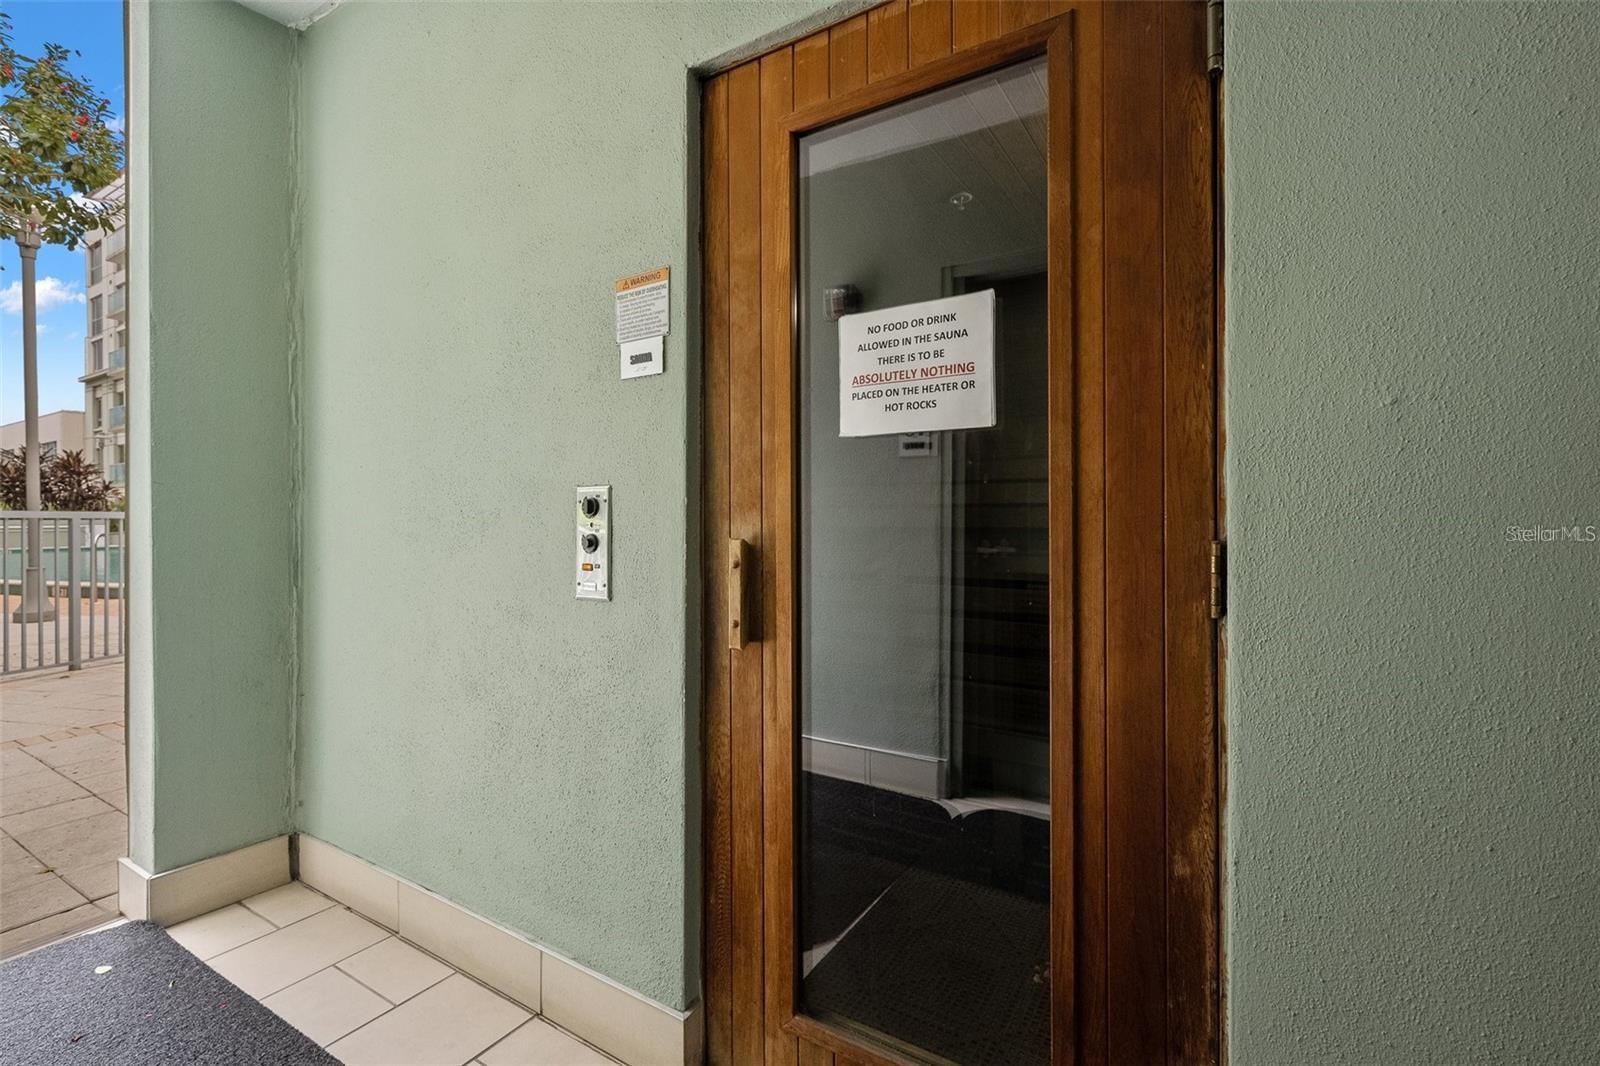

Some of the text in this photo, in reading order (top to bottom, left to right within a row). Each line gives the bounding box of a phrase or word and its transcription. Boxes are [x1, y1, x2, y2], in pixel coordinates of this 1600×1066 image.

[630, 272, 661, 286] WARNING
[867, 313, 957, 334] NO FOOD OR DRINK
[858, 328, 968, 352] ALLOWED IN THE SAUNA
[878, 349, 945, 365] THERE IS TO BE
[852, 362, 975, 388] ABSOLUTELY NOTHING
[852, 380, 975, 401] PLACED ON THE HEATER OR
[884, 400, 937, 412] HOT ROCKS
